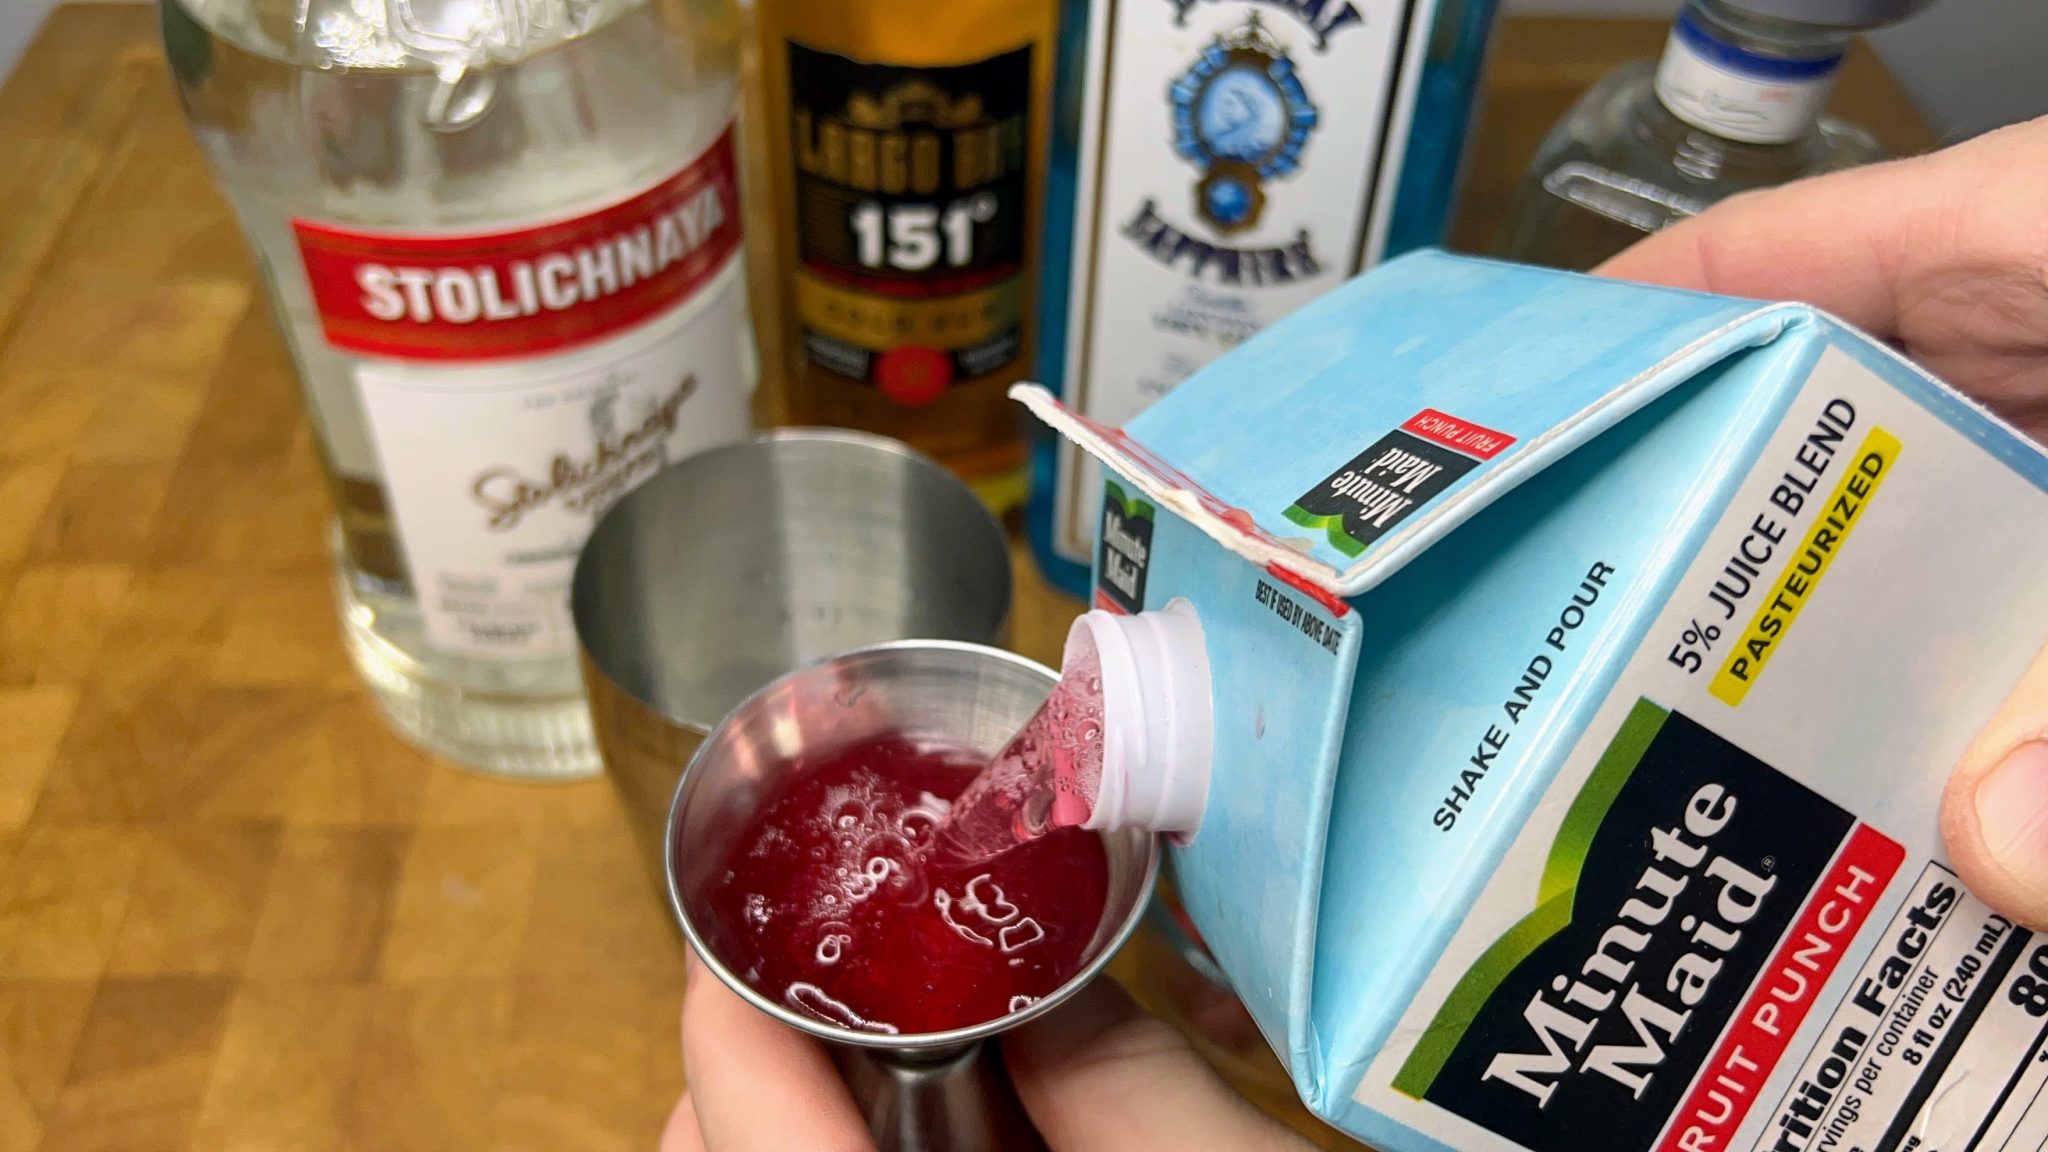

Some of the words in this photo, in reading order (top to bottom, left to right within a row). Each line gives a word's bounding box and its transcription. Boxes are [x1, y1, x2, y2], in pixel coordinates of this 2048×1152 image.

[355, 186, 727, 324] STOLICHNAYA
[1414, 415, 1458, 440] PUNCH
[1456, 431, 1502, 453] FRUIT
[1331, 470, 1412, 529] Minute
[1363, 447, 1443, 495] Maid
[1667, 618, 1722, 675] 5%
[1708, 513, 1787, 620] JUICE
[1769, 398, 1856, 517] BLEND
[1729, 452, 1884, 682] PASTEURIZED
[1255, 579, 1272, 606] BEST
[1276, 594, 1293, 621] USED
[1291, 604, 1303, 628] BY
[1301, 611, 1325, 643] ABOVE
[1322, 625, 1342, 656] DATE
[1433, 724, 1511, 832] SHAKE
[1504, 653, 1553, 724] AND
[1545, 559, 1616, 652] POUR
[1481, 781, 1738, 1110] Minute
[1751, 864, 1876, 1037] PUNCH
[1974, 914, 2013, 956] mL)
[1578, 855, 1779, 1101] Maid
[1764, 1026, 1868, 1152] rition
[1852, 881, 1957, 1018] Facts
[1928, 1003, 1953, 1030] oz
[1942, 954, 1982, 1004] (240
[1853, 1057, 1883, 1096] per
[1876, 964, 1940, 1058] container
[1902, 1047, 1923, 1067] 8
[1912, 1029, 1936, 1049] fl
